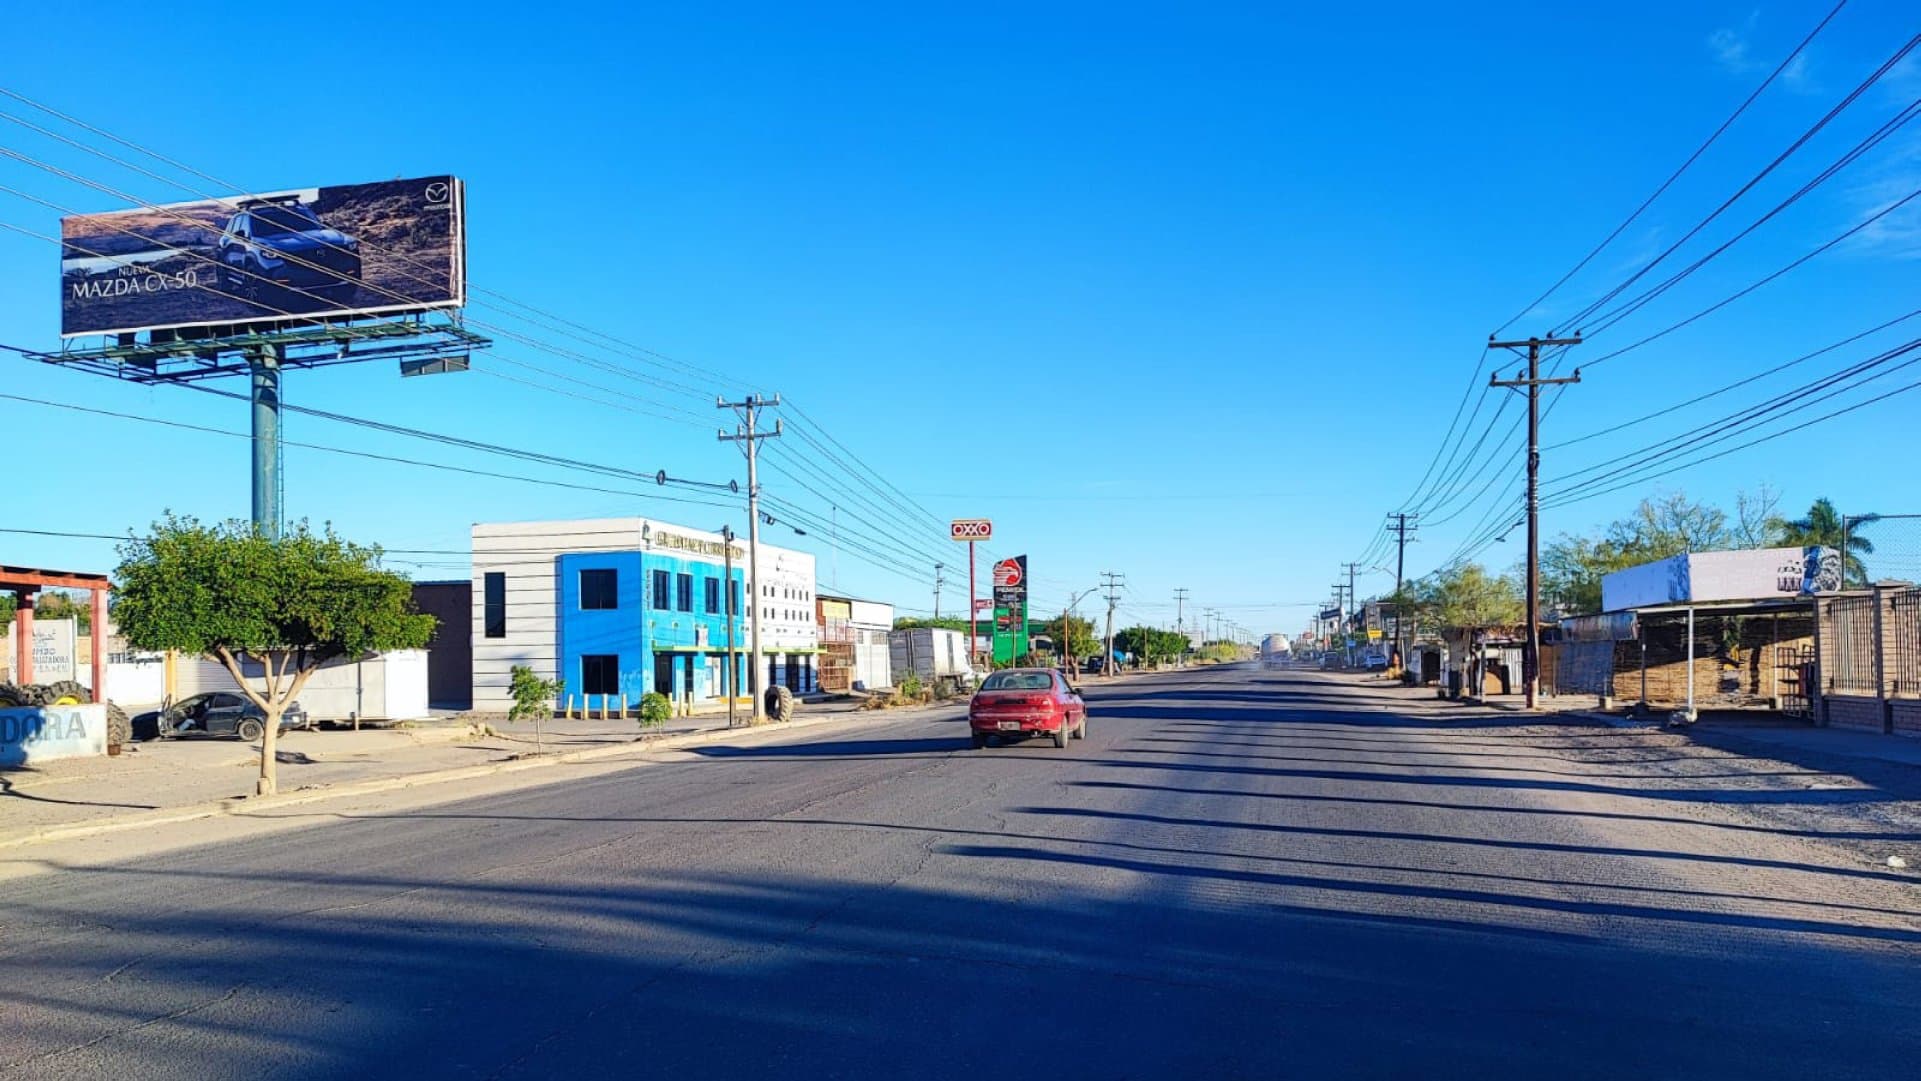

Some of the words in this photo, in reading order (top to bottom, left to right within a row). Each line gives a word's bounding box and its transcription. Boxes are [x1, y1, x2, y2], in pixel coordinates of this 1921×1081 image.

[72, 278, 140, 299] MAZDA
[145, 270, 197, 292] CX-50
[953, 522, 989, 537] OXXO
